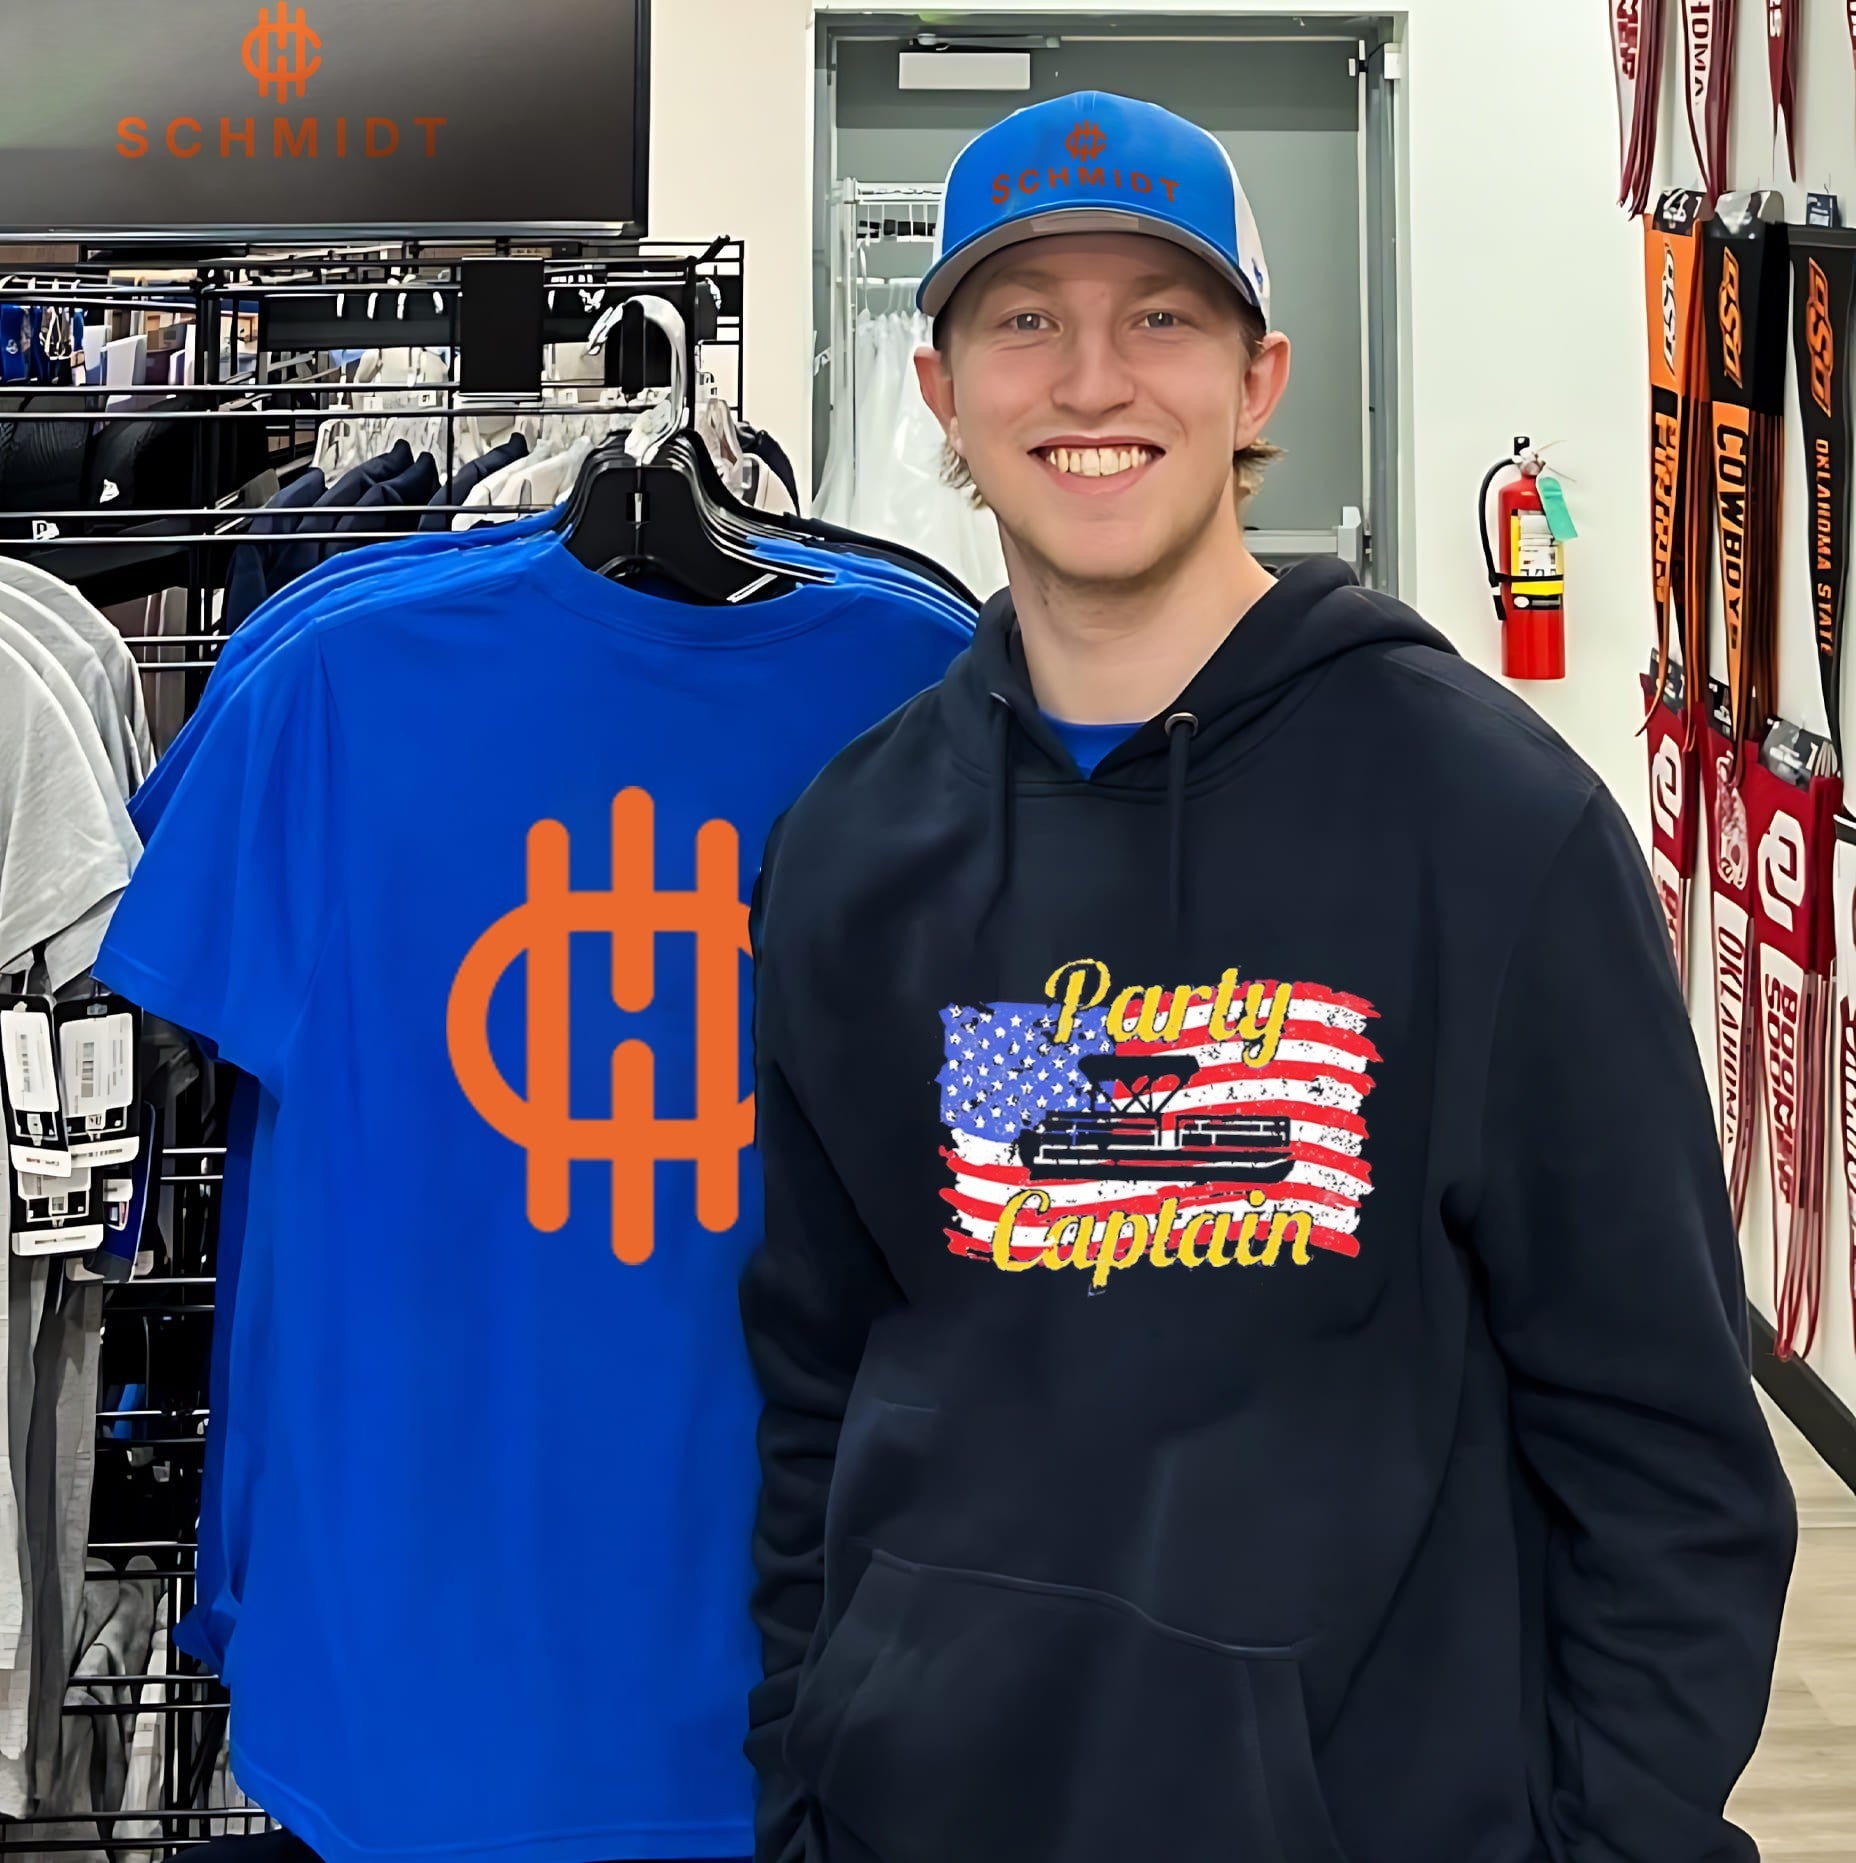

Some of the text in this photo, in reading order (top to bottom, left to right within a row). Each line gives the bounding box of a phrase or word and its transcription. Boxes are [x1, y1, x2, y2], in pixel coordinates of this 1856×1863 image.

[116, 117, 447, 158] SCHMIDT
[992, 167, 1179, 204] SCHMIDT
[1815, 438, 1832, 570] OKLAHOMA
[1045, 958, 1293, 1068] Party
[992, 1189, 1314, 1290] Captain
